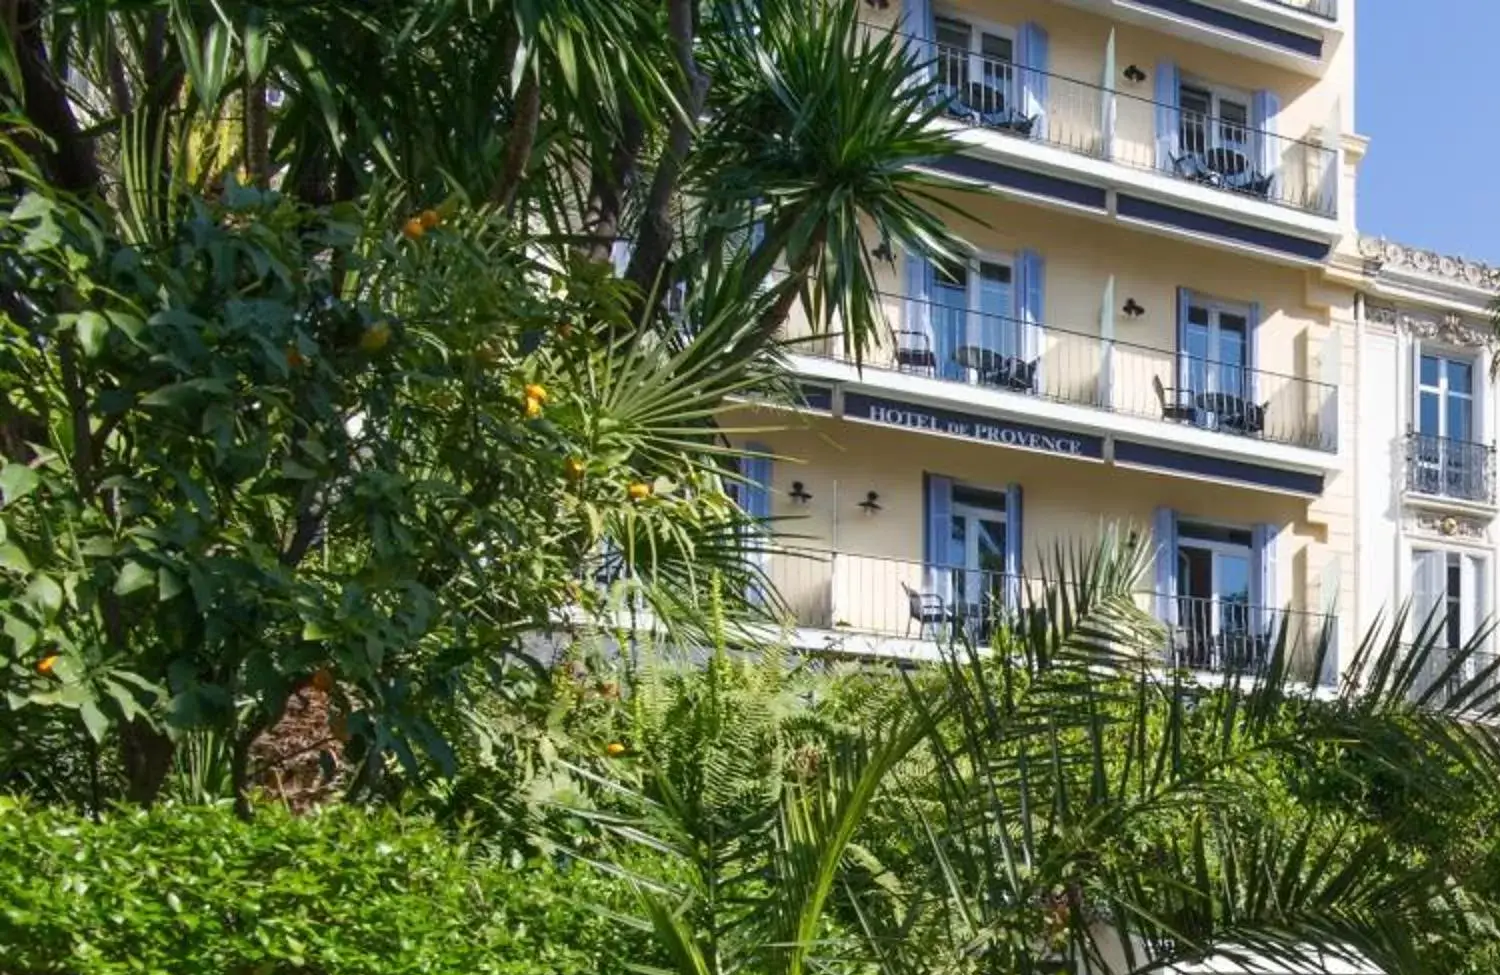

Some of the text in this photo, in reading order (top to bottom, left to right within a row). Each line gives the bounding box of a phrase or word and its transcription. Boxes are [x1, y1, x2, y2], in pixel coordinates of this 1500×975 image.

[869, 405, 1082, 455] HOTEL DE PROVENCE
